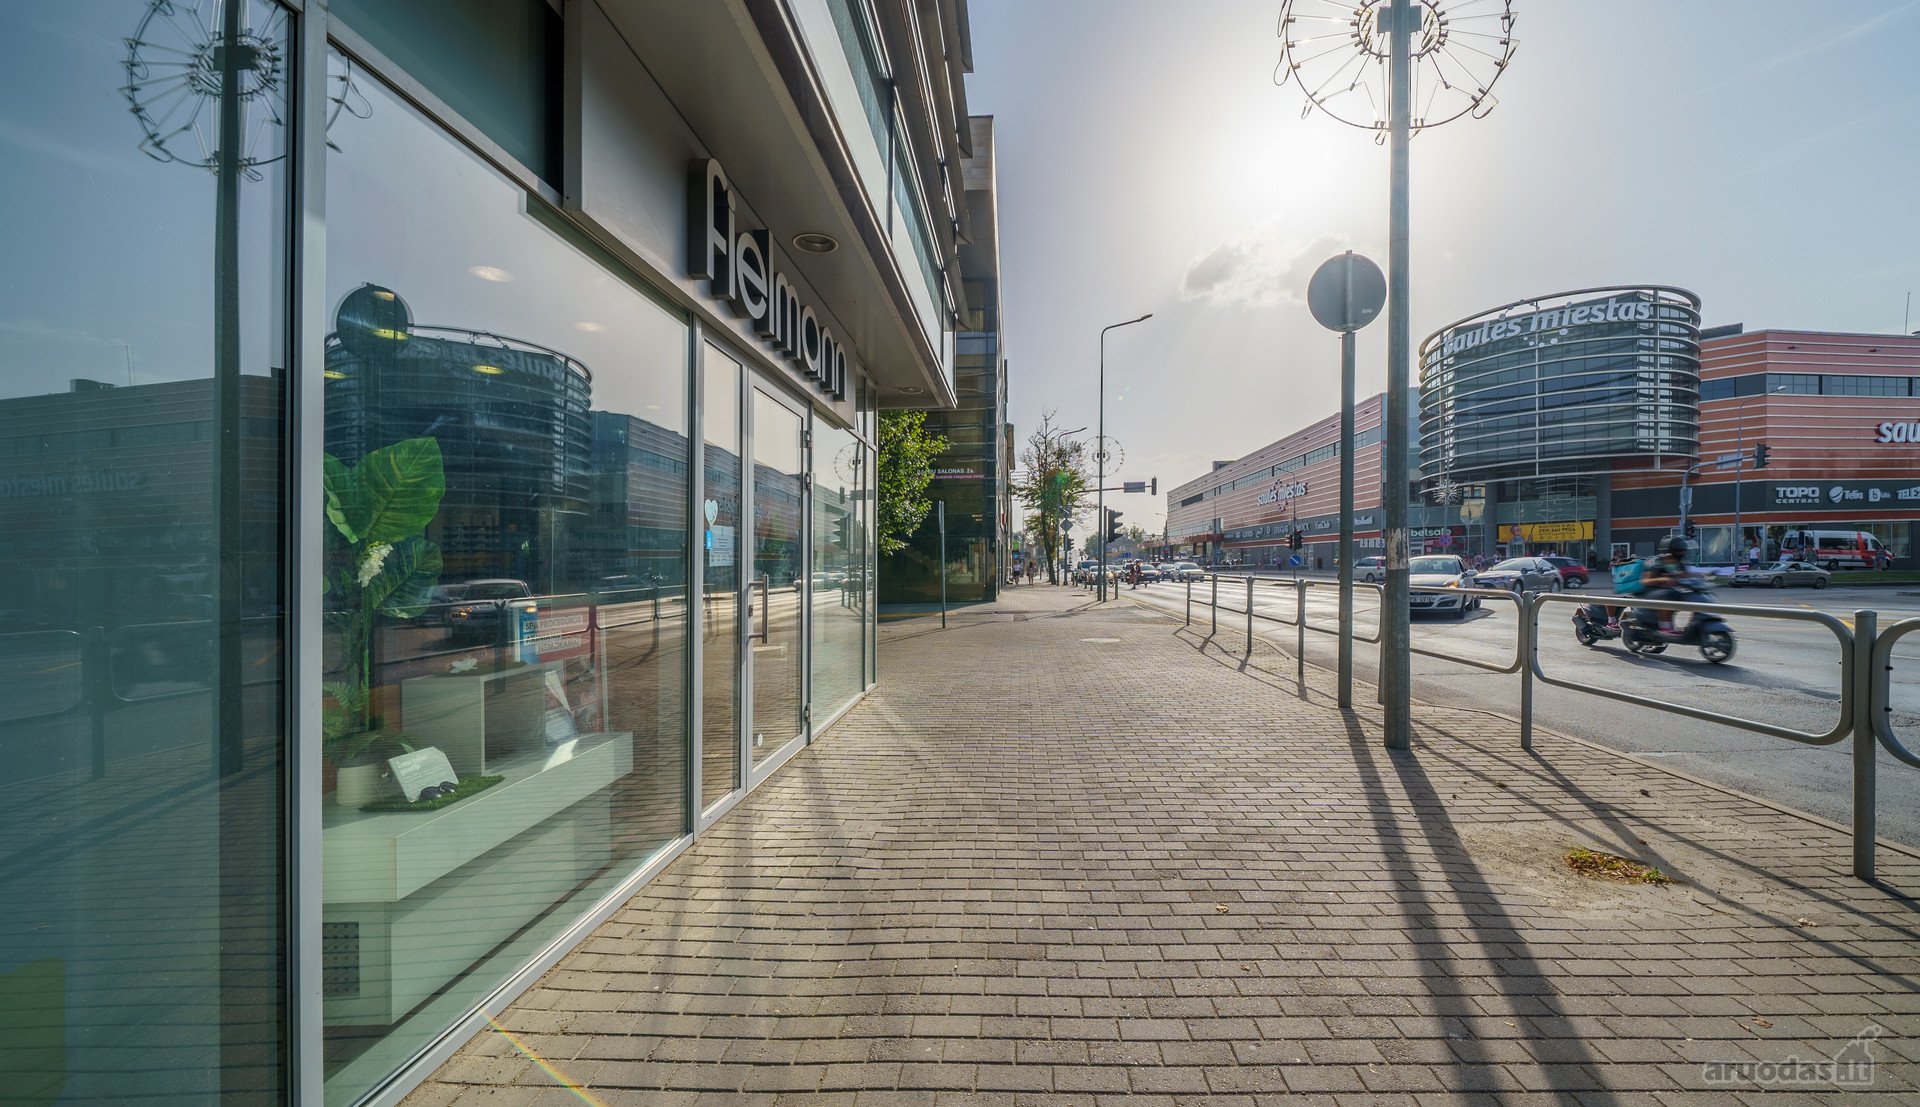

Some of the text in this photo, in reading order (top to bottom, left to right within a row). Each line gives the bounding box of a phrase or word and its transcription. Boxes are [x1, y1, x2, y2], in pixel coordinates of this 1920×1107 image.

[691, 157, 847, 402] fielmann
[1529, 298, 1651, 332] miestas
[1775, 487, 1819, 498] TOPO
[1843, 490, 1864, 500] Telia
[1411, 528, 1452, 537] betsafe
[525, 619, 539, 631] SPA
